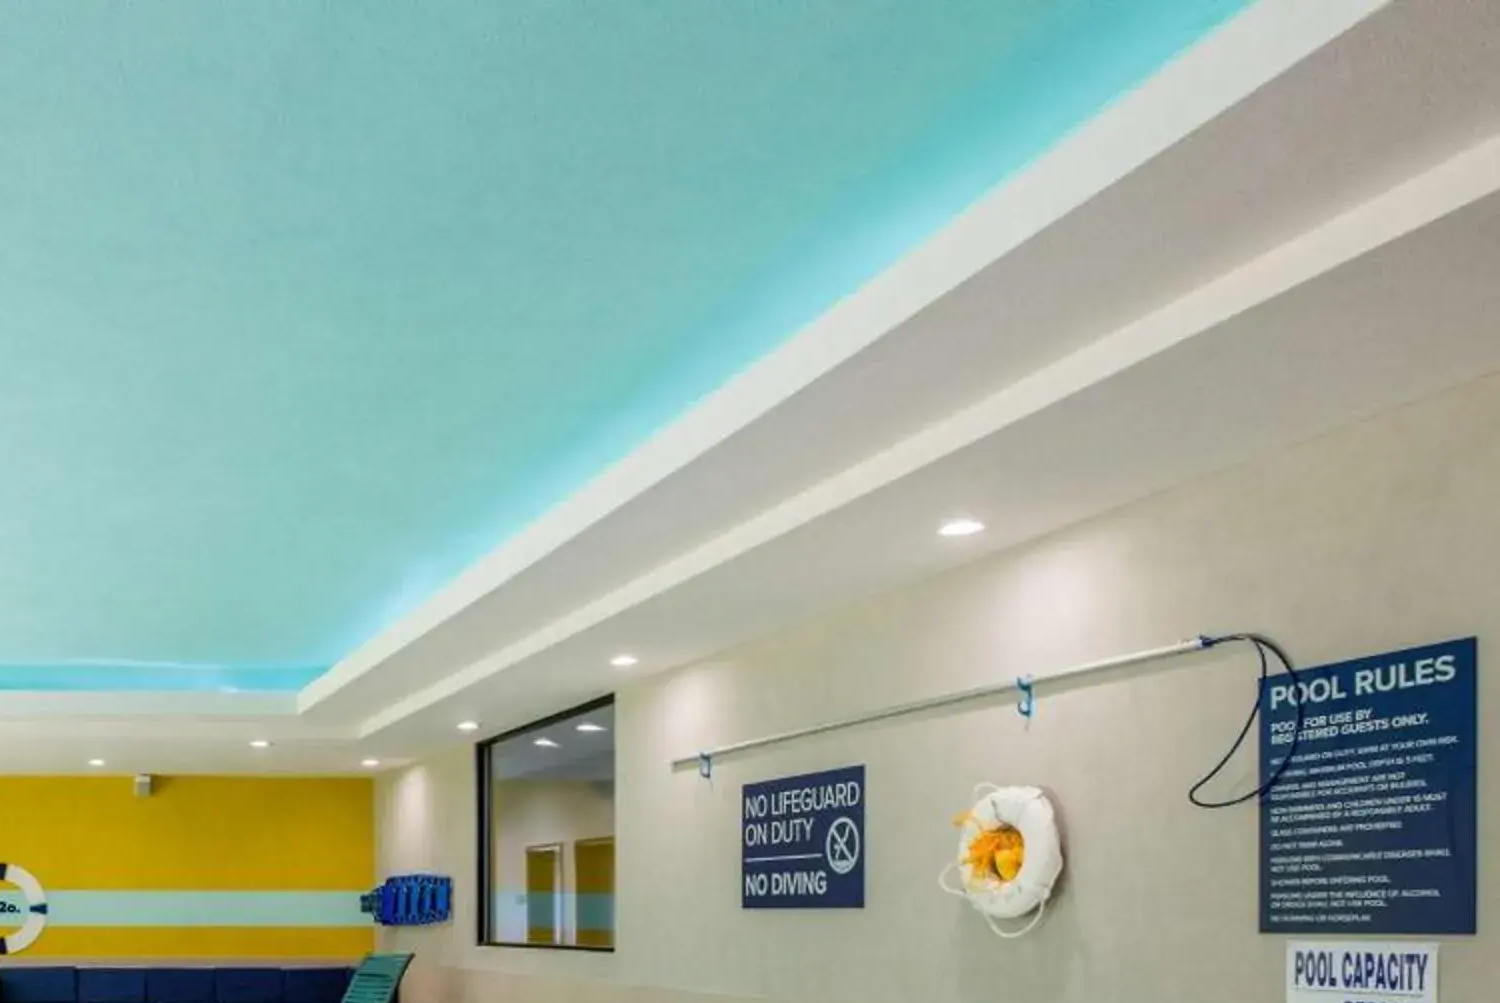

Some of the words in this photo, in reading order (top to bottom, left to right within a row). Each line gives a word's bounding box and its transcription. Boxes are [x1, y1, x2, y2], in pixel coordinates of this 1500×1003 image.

[1270, 676, 1346, 710] POOL
[1355, 655, 1456, 696] RULES
[1271, 721, 1299, 733] POO
[1304, 713, 1327, 728] FOR
[1329, 711, 1353, 725] USE
[1355, 708, 1373, 721] BY
[1341, 719, 1389, 735] GUESTS
[745, 795, 767, 819] NO
[771, 782, 859, 816] LIFEGUARD
[745, 822, 767, 847] ON
[771, 818, 814, 845] DUTY
[745, 872, 768, 896] NO
[771, 871, 827, 896] DIVING
[1295, 950, 1337, 987] POOL
[1341, 951, 1429, 991] CAPACITY
